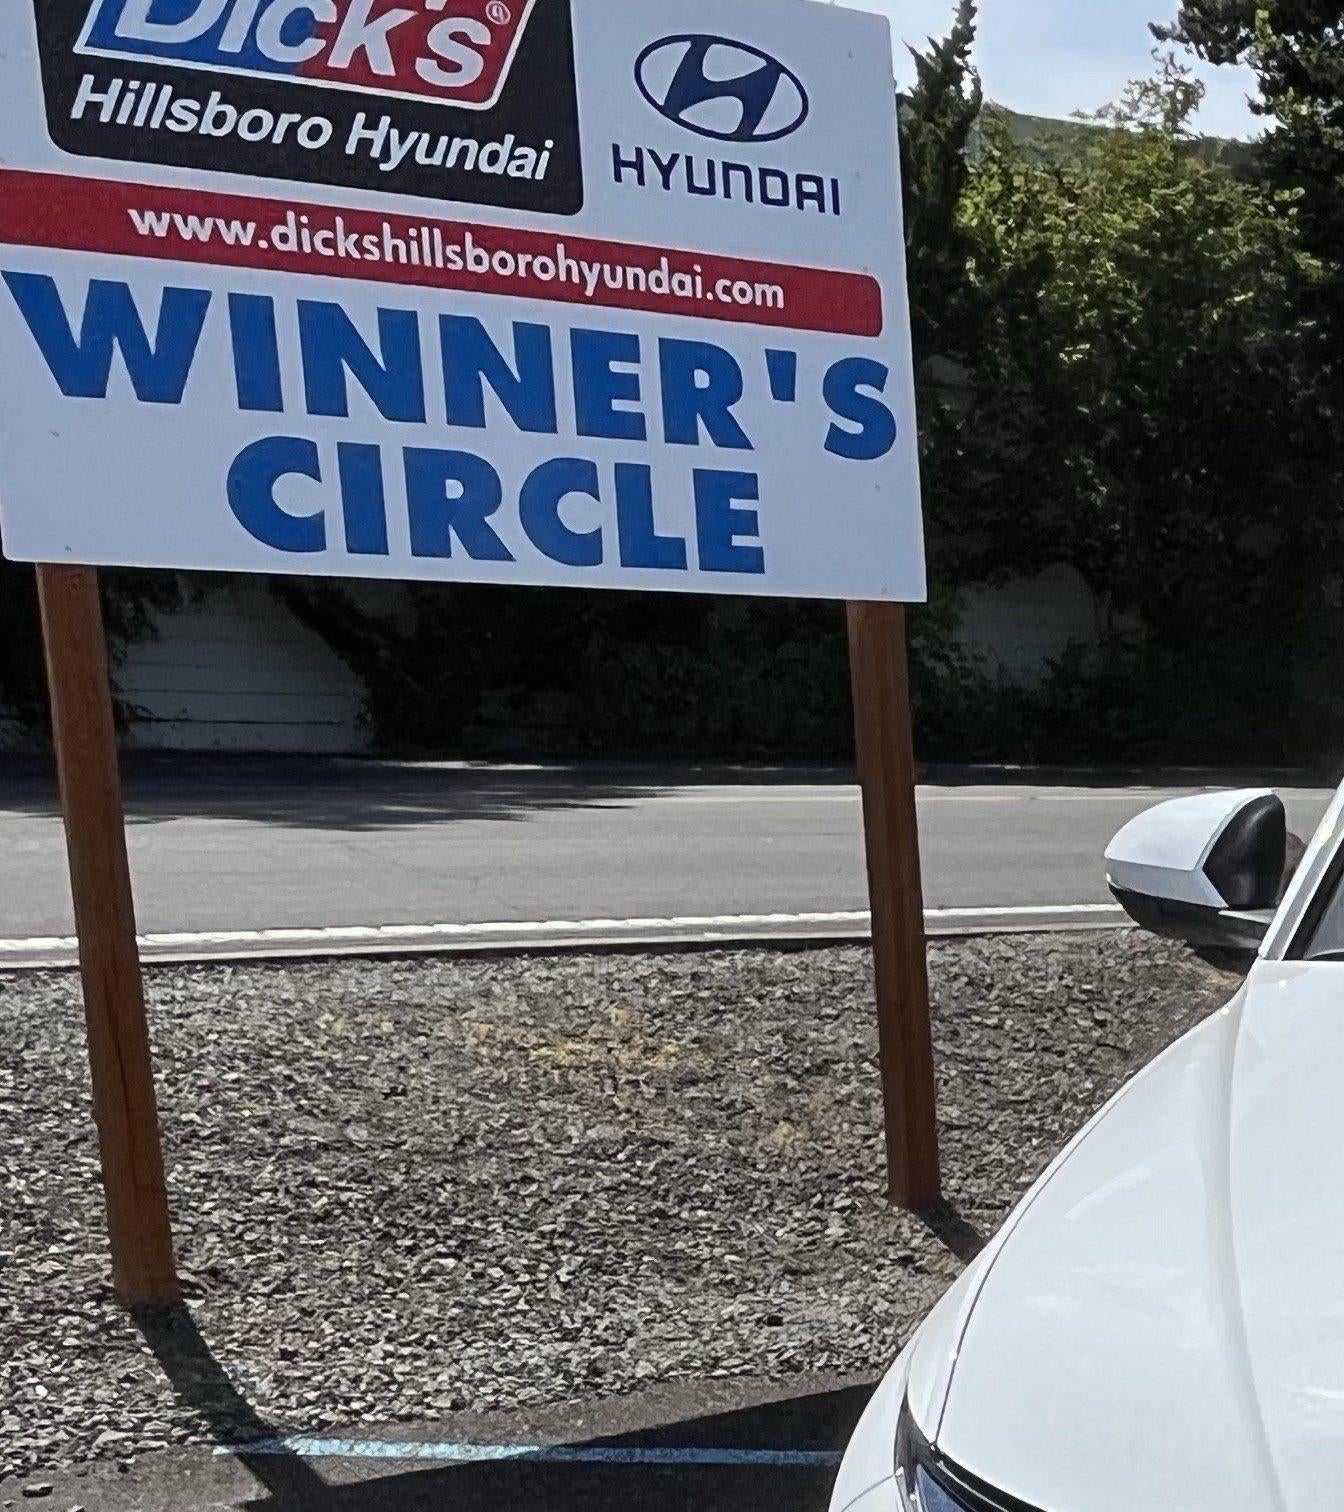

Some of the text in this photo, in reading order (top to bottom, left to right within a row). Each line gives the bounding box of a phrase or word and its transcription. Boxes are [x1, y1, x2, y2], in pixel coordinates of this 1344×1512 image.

[70, 74, 554, 180] Hillsboro Hyundai
[612, 144, 839, 215] HYUNDAI
[128, 206, 785, 310] www.dickshillsborohyundai.com
[0, 271, 898, 461] WINNER'S
[226, 436, 765, 575] CIRCLE
